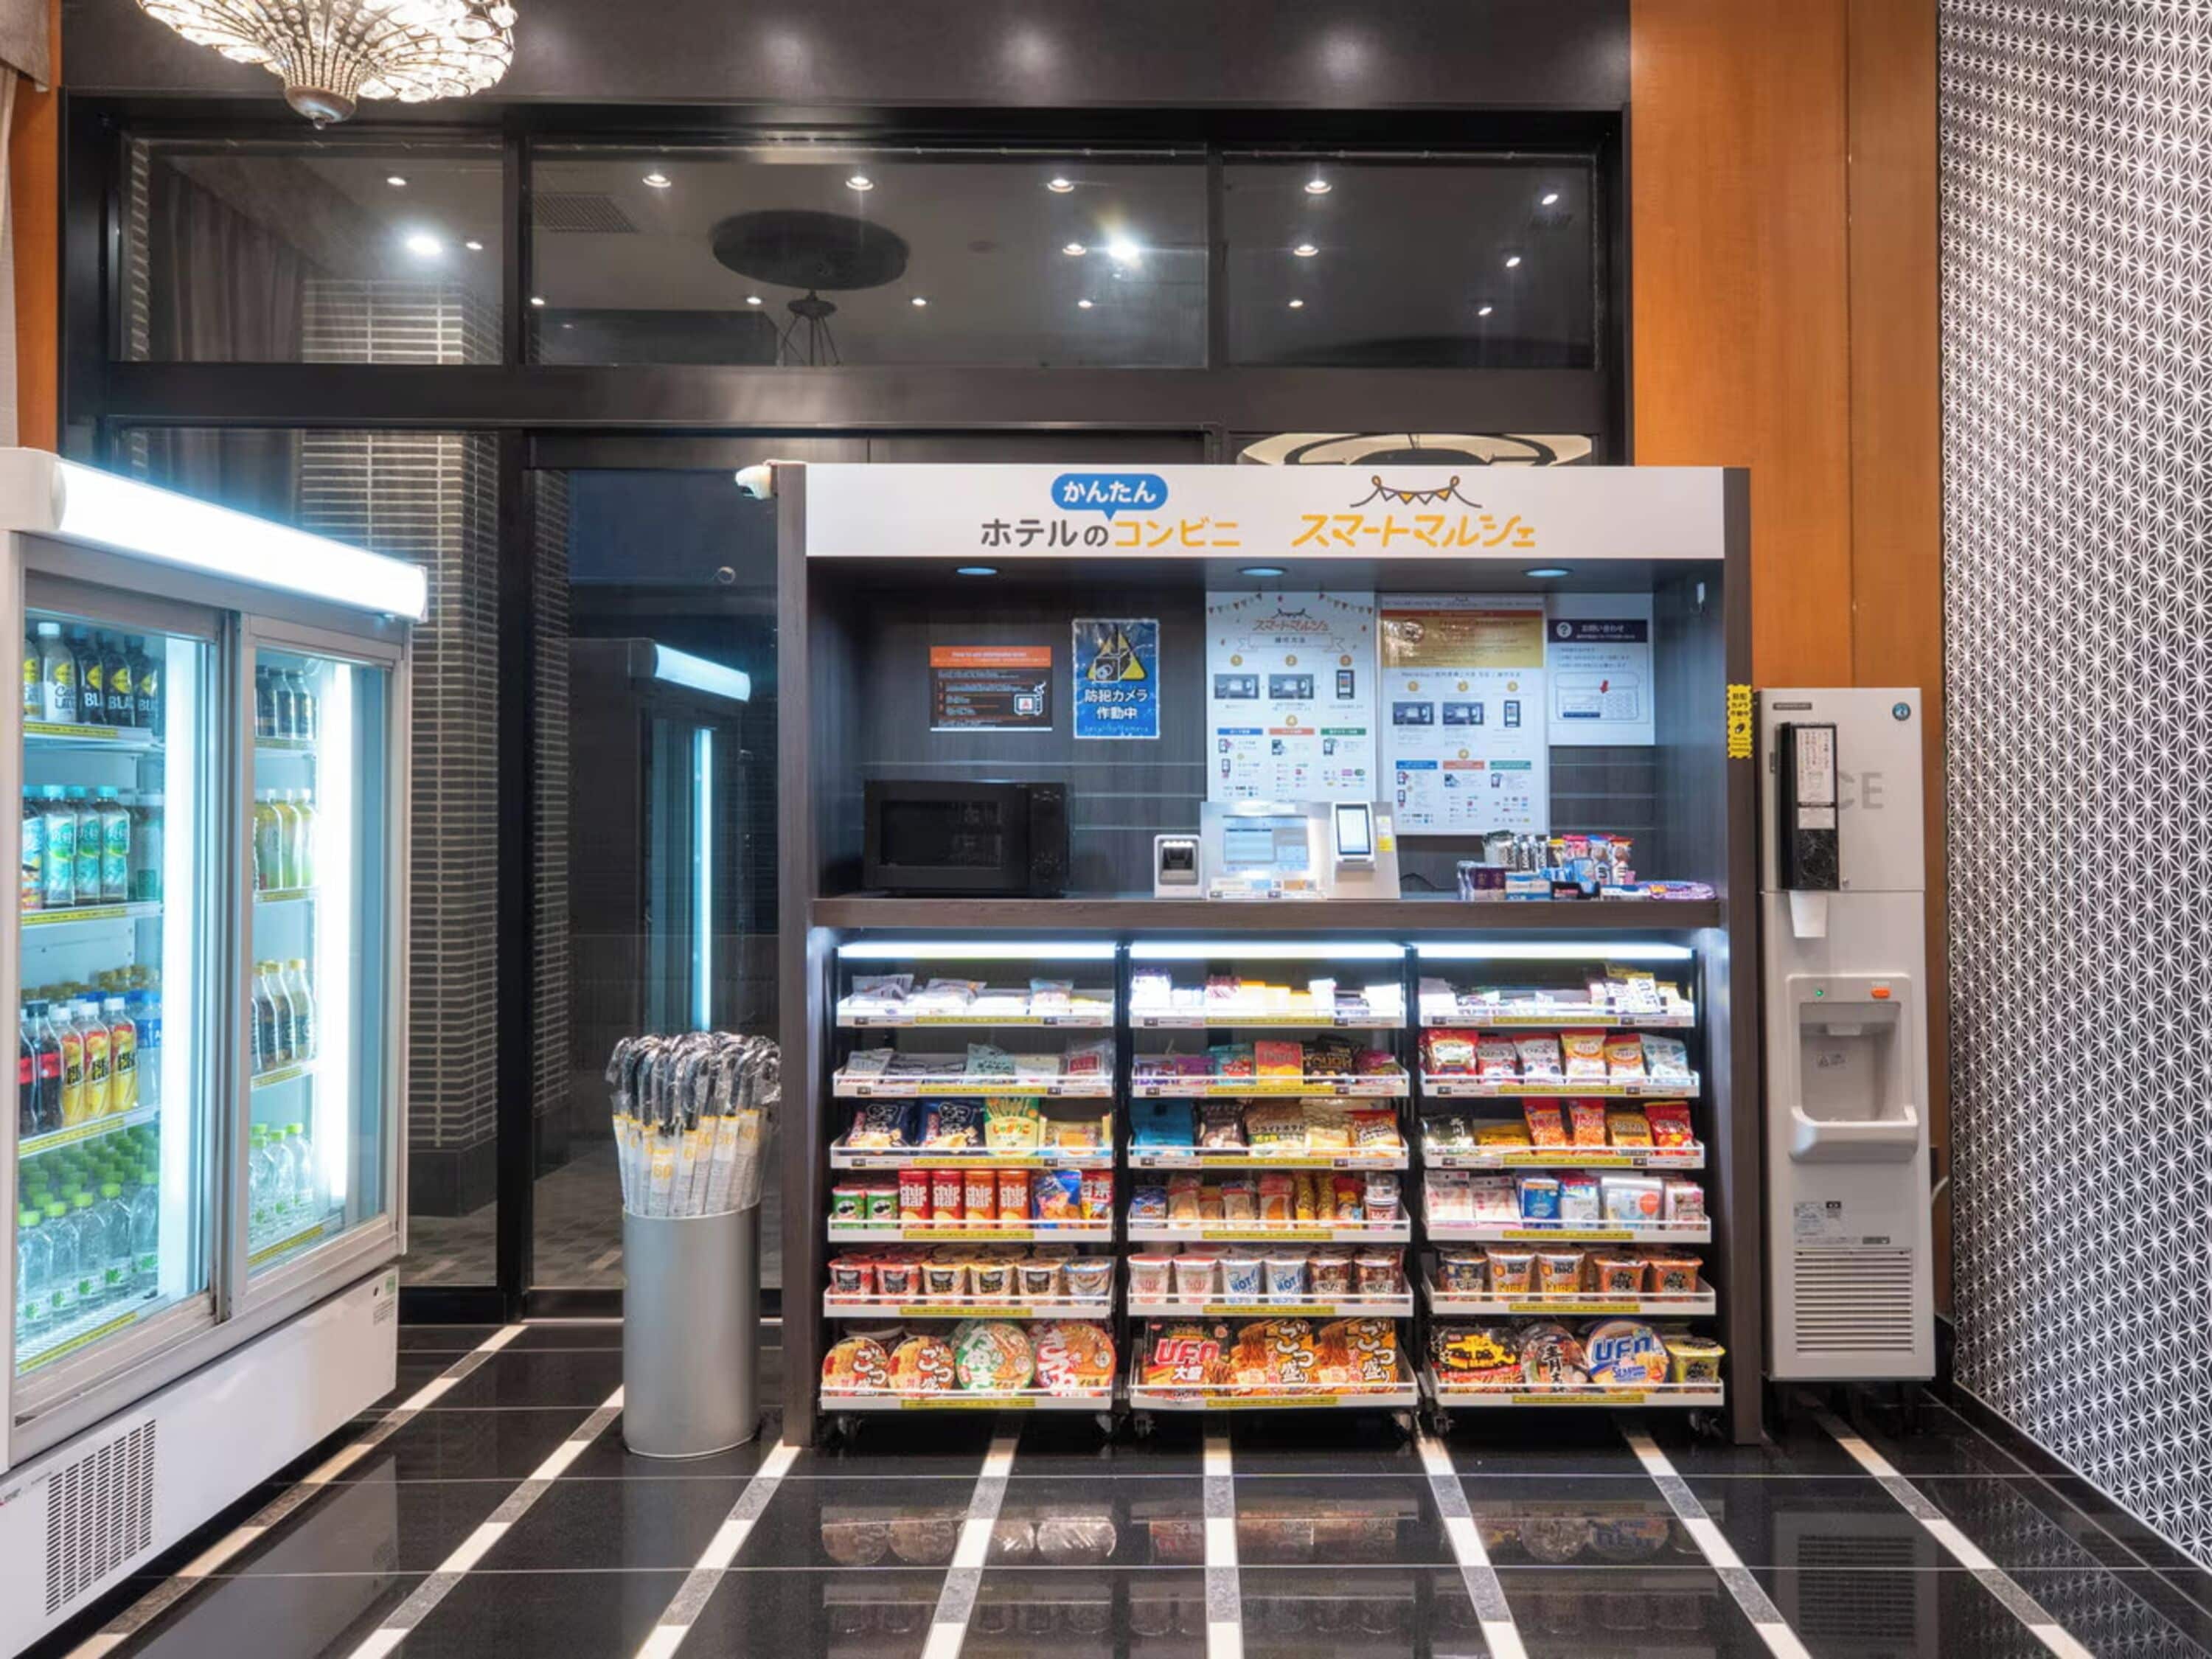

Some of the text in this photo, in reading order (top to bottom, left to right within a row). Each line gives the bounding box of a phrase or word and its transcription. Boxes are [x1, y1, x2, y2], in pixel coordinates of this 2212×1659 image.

[1063, 482, 1157, 504] かんたん
[981, 518, 1240, 548] ホテルのコンビニ
[1291, 514, 1536, 548] スマートマルシェ
[1085, 689, 1148, 703] 防犯カメラ
[1096, 706, 1138, 720] 作動中
[1837, 771, 1884, 810] CE
